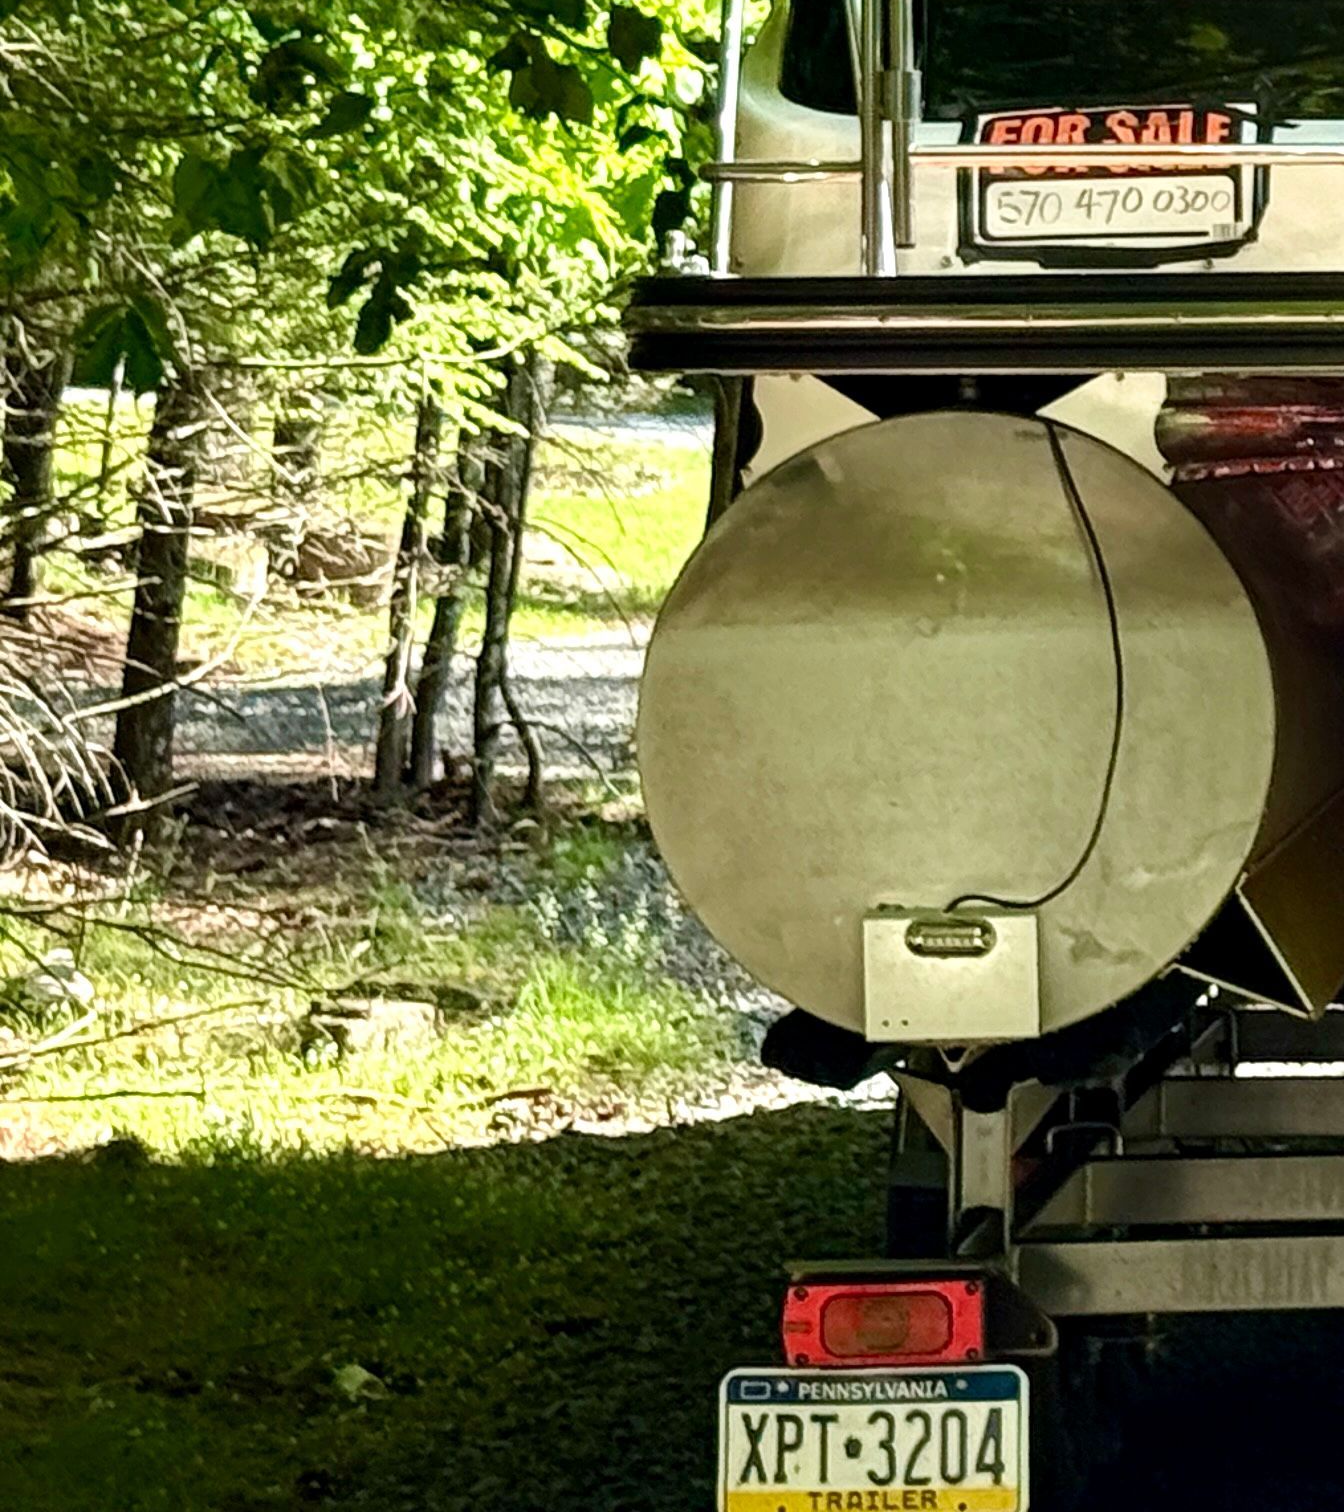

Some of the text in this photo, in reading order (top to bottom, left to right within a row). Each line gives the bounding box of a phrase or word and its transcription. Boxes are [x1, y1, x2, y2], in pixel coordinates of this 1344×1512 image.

[988, 110, 1232, 175] FOR SALE
[997, 185, 1231, 226] 570 470 0300
[797, 1380, 948, 1401] PENNSYLVANIA
[808, 1490, 938, 1511] TRAILER
